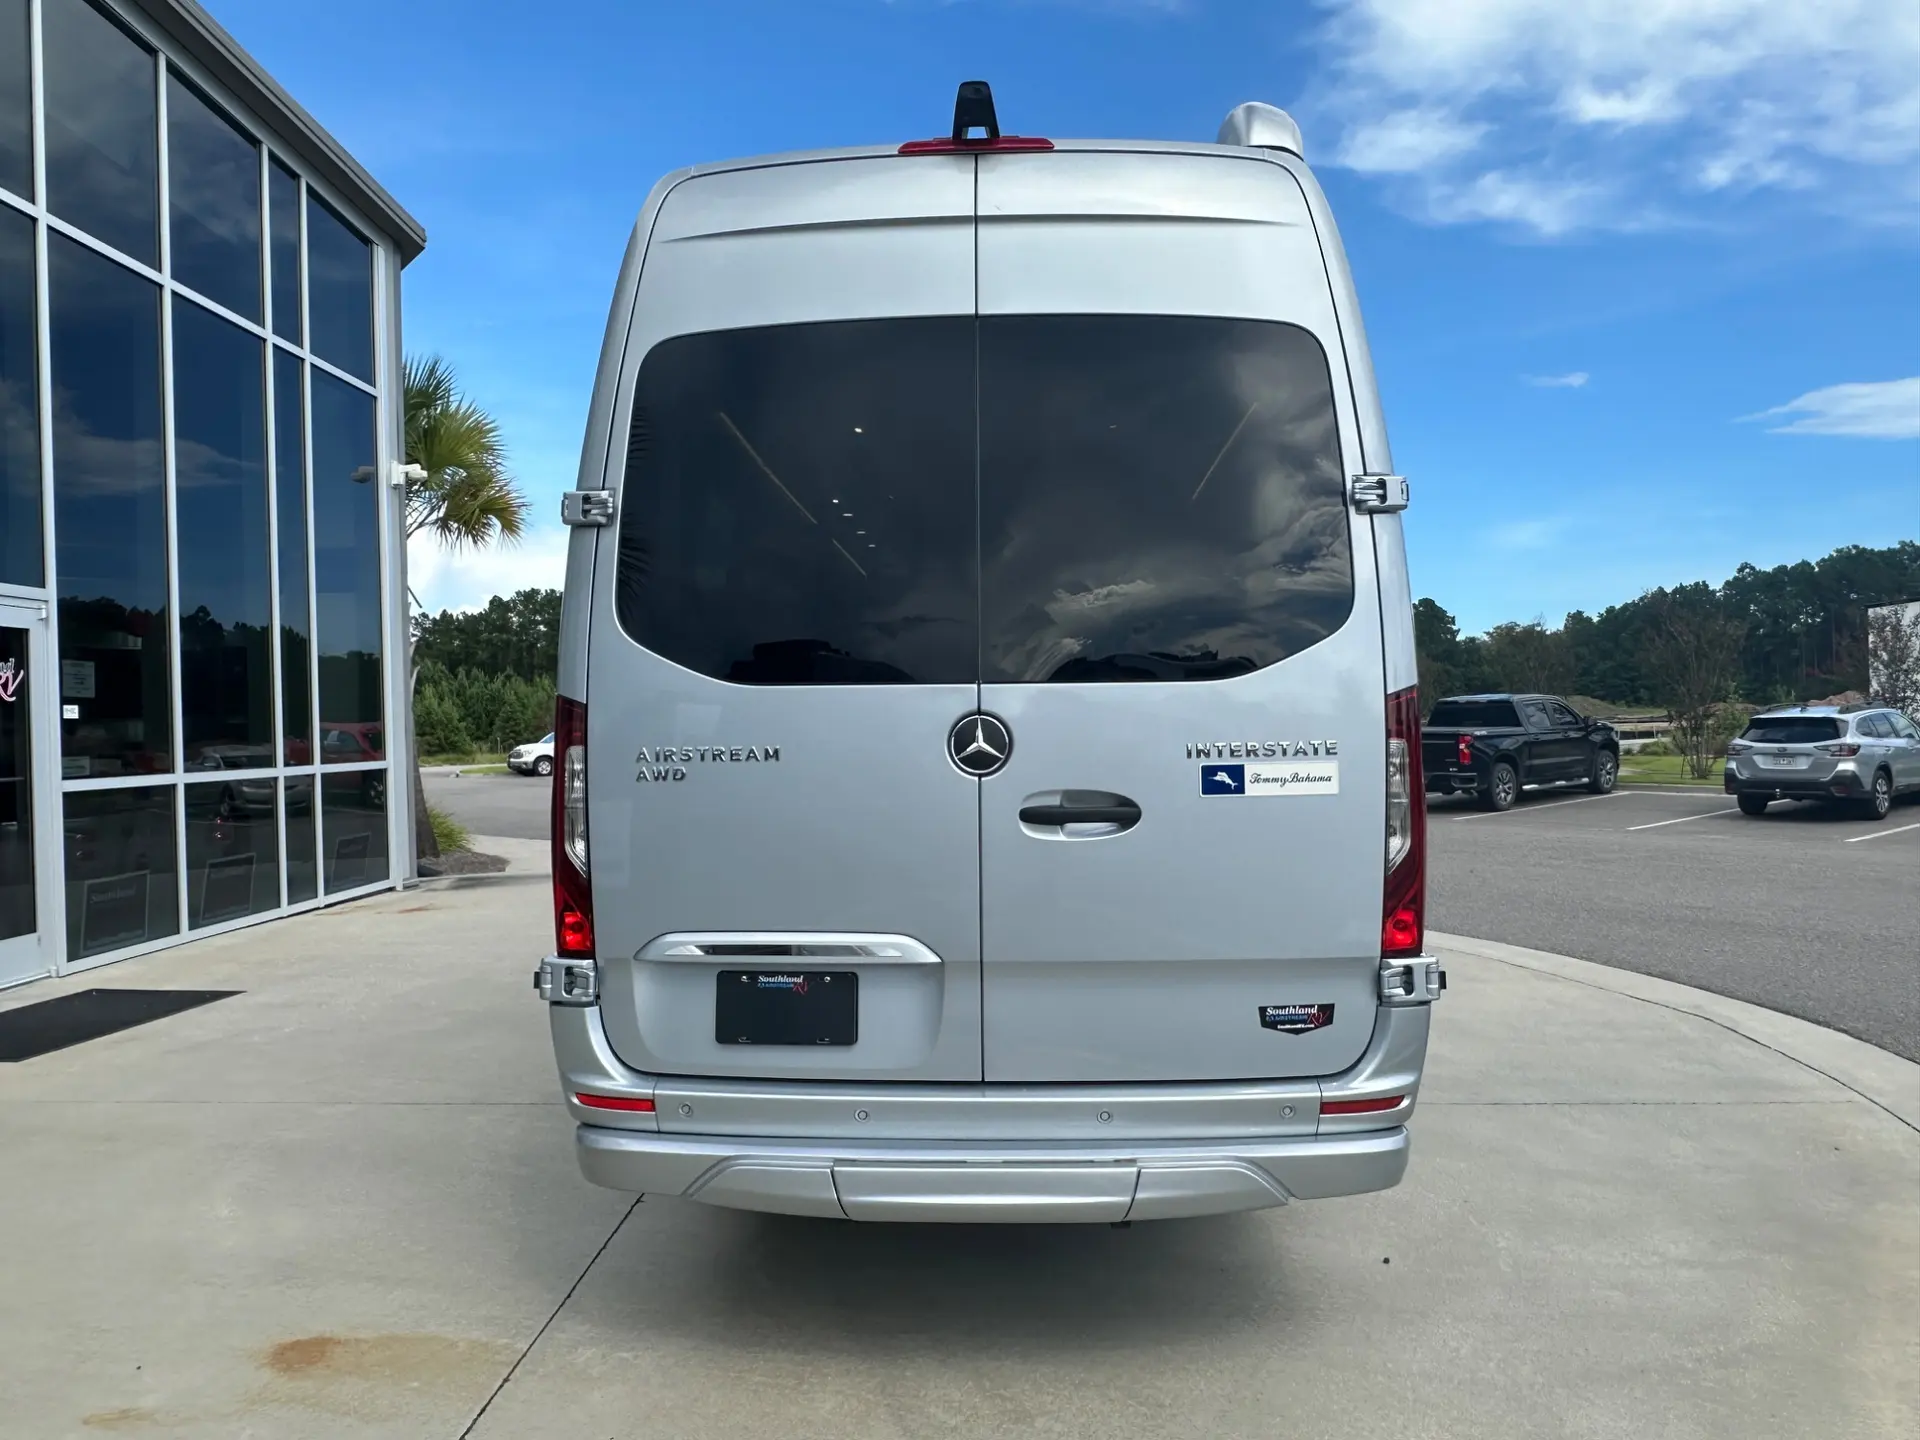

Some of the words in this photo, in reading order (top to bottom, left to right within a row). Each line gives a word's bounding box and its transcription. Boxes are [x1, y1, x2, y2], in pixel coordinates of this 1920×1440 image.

[636, 745, 780, 763] AIRSTREAM
[1186, 740, 1338, 759] INTERSTATE
[636, 766, 686, 782] AWD
[1250, 772, 1287, 787] Tommy
[1287, 772, 1332, 783] Bahama
[758, 974, 804, 983] Southland
[1266, 1005, 1318, 1015] Southland
